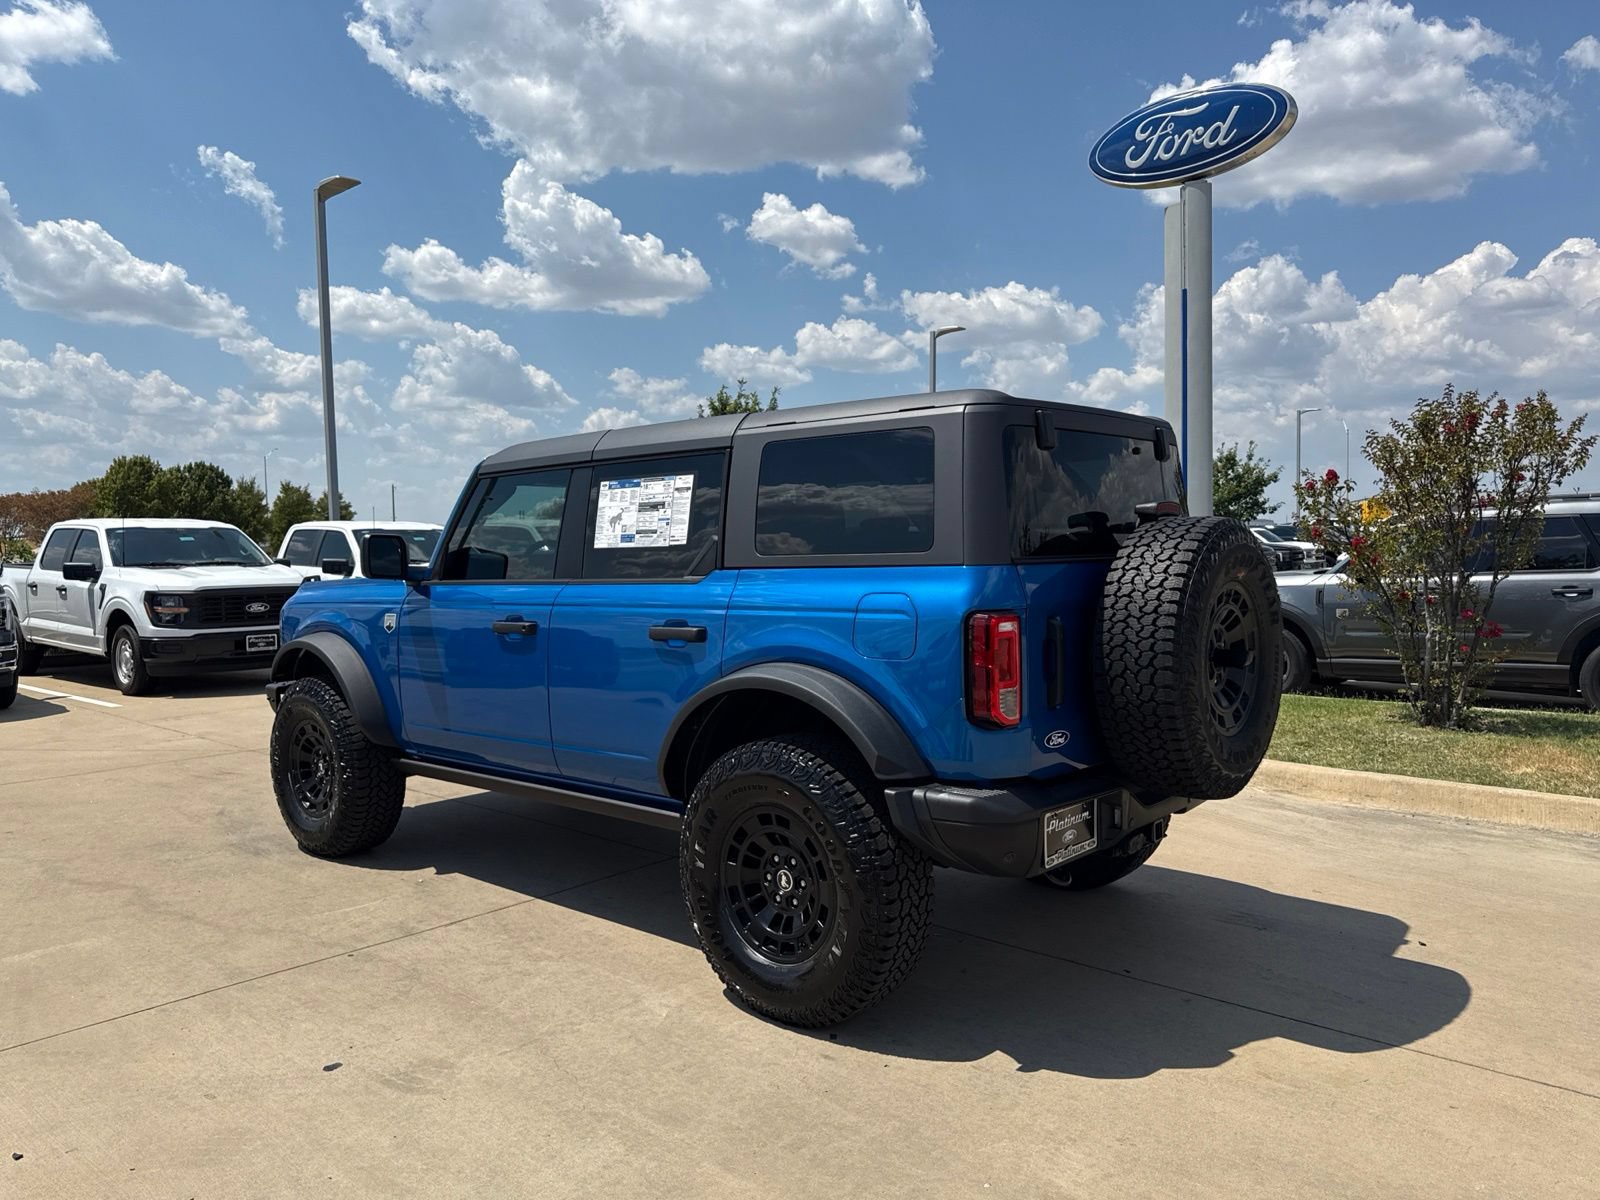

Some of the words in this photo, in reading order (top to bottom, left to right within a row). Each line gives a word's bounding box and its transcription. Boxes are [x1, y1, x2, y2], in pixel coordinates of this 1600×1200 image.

[1125, 101, 1241, 168] Ford
[1050, 733, 1066, 746] Ford
[1046, 810, 1092, 834] Platinum
